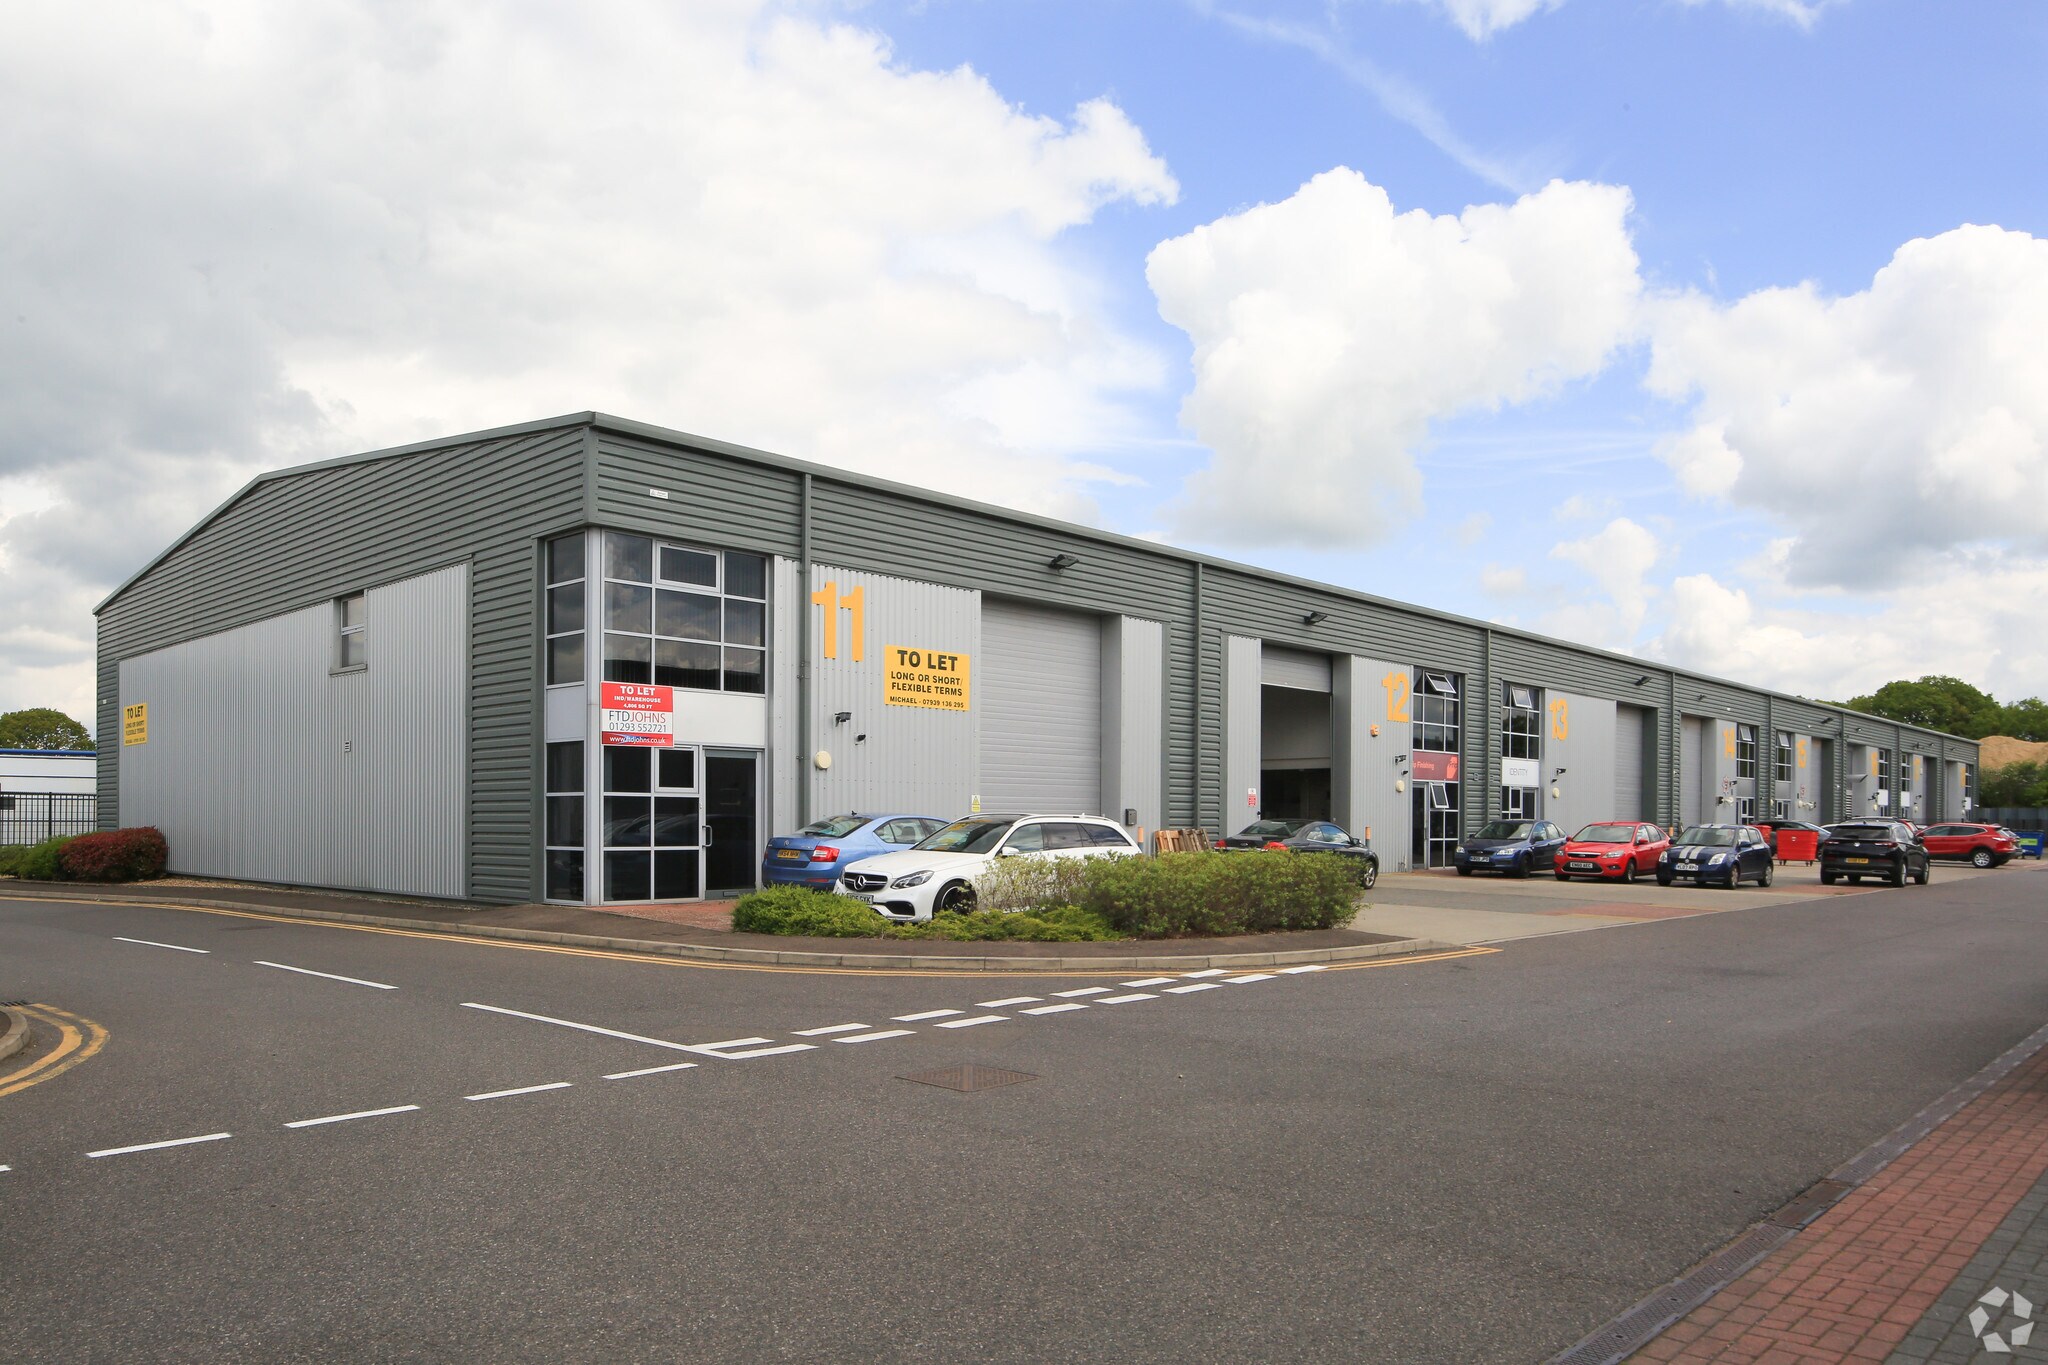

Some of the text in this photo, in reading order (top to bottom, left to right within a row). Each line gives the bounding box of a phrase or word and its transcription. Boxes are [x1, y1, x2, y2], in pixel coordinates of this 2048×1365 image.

[812, 582, 863, 662] 11
[897, 650, 958, 671] TO LET
[891, 671, 915, 681] LONG
[918, 674, 930, 682] OR
[620, 685, 656, 696] TO LET
[891, 682, 963, 697] FLEXIBLE TERMS
[614, 695, 661, 703] IND/WAREHOUSE
[889, 696, 917, 704] MICHAEL
[1382, 671, 1409, 723] 12
[127, 705, 144, 719] TO LET
[609, 710, 666, 724] FTDJOHNS
[1549, 698, 1568, 740] 13
[609, 722, 667, 733] 01293 552721
[609, 736, 666, 745] www.ftdjohns.co.uk
[1723, 726, 1735, 760] 14
[1417, 761, 1434, 771] Finishing
